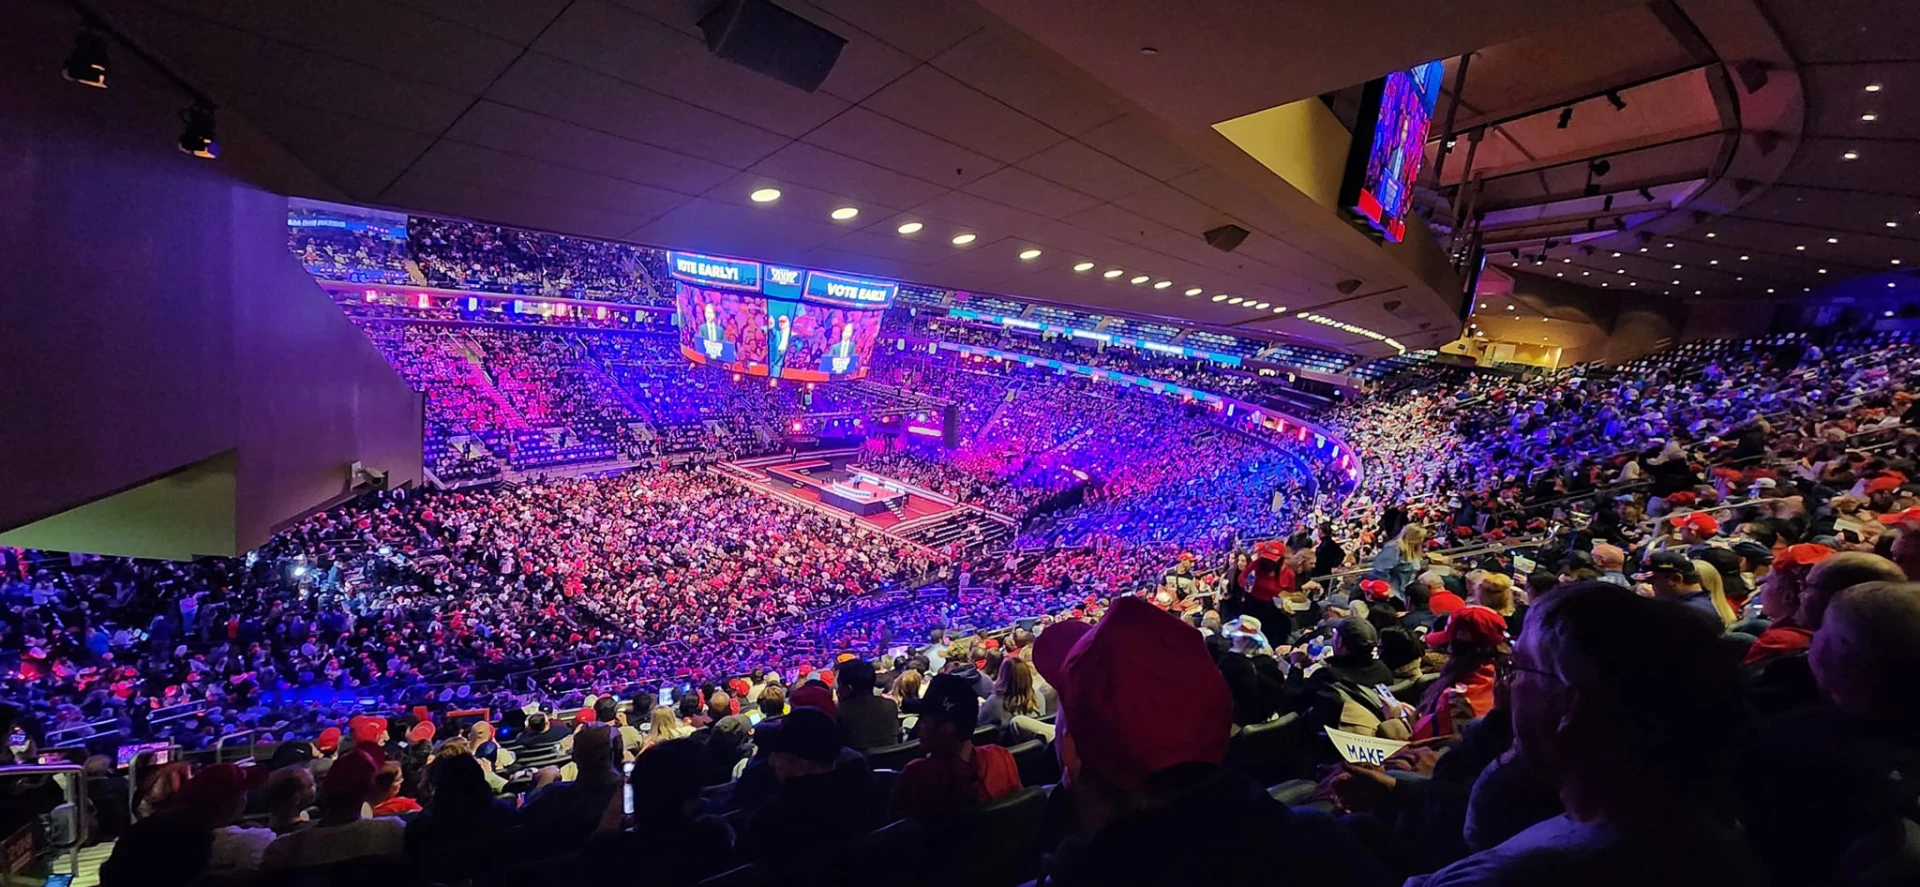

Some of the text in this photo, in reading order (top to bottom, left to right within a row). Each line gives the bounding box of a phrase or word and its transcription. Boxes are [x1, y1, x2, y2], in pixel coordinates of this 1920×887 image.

[677, 258, 739, 281] VOTE EARLY!
[828, 282, 859, 299] VOTE
[1346, 743, 1385, 765] MAKE
